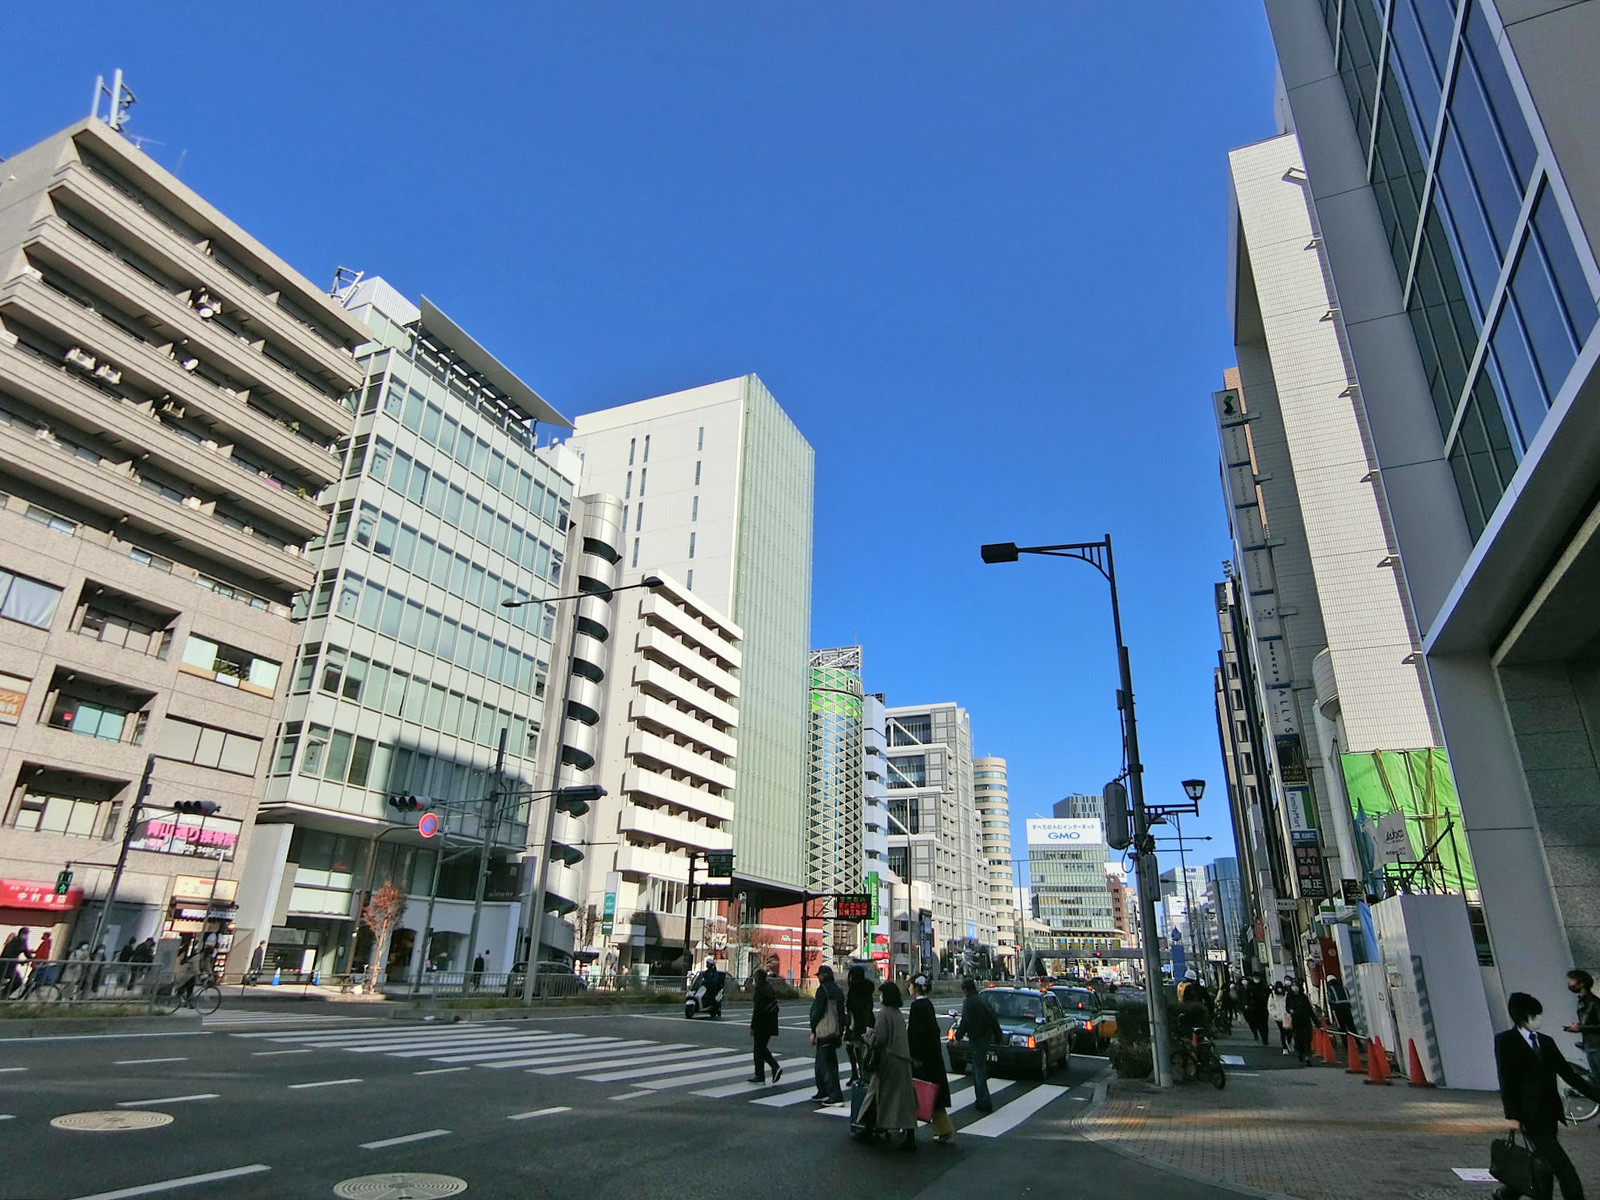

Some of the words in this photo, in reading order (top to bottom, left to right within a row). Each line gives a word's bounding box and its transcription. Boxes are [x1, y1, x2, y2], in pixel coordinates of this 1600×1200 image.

[1278, 690, 1294, 734] ALLYS
[1289, 792, 1301, 828] FamilyMart
[1048, 831, 1080, 840] GMO
